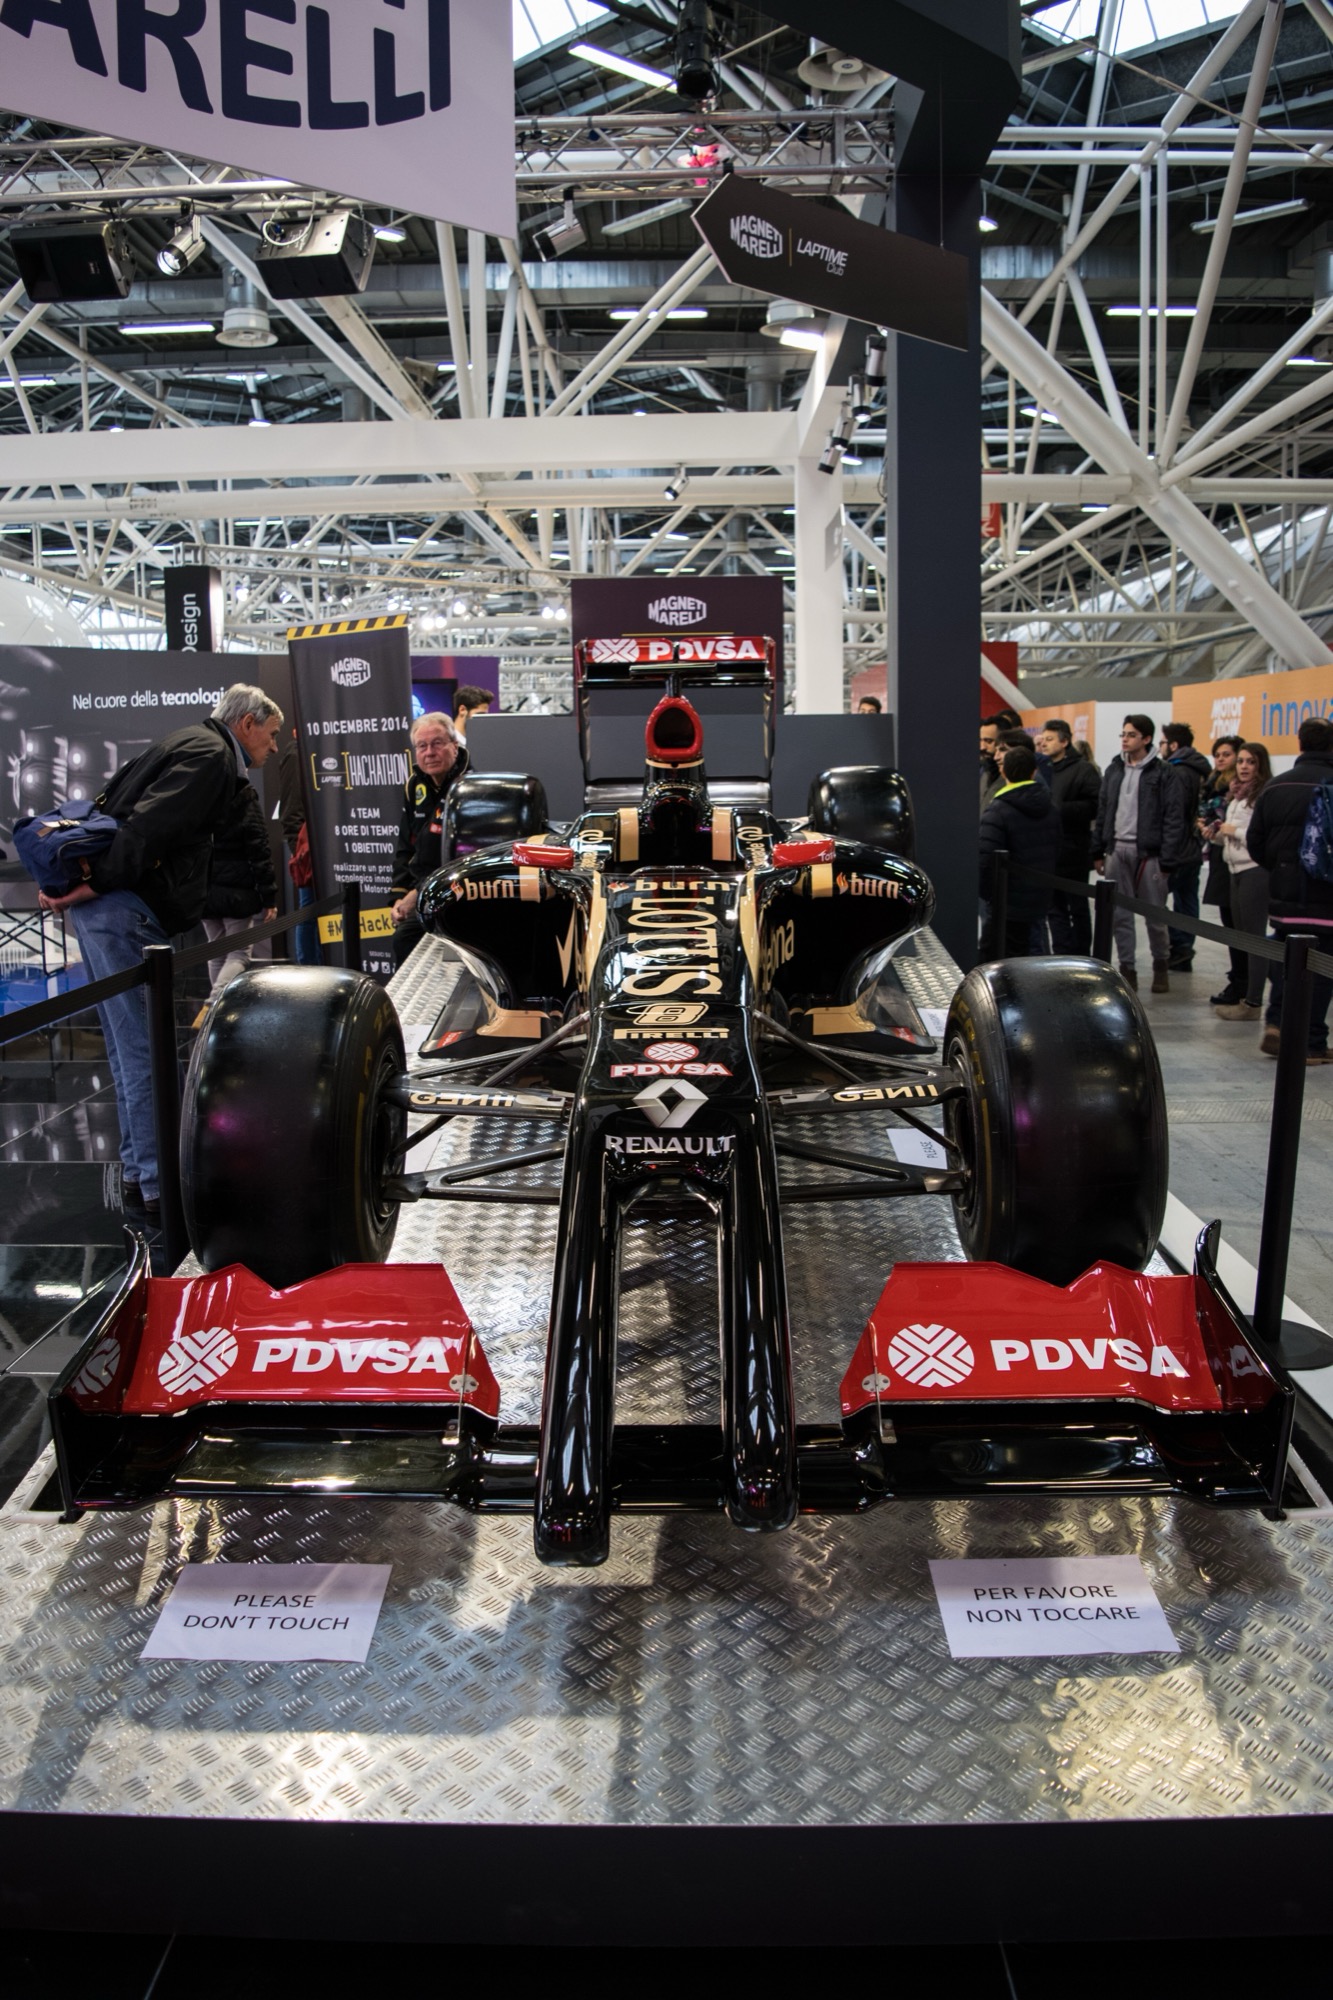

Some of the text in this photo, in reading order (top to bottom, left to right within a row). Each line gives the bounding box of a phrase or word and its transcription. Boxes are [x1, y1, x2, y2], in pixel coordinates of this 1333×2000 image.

[797, 238, 848, 267] LAPTIME
[826, 262, 844, 276] Club
[181, 593, 201, 653] esign
[649, 640, 760, 660] PDVSA
[73, 687, 227, 710] Nel cuore della tecnologi
[307, 716, 409, 736] 10 DICEMBRE 2014
[348, 752, 409, 787] HACKATHON
[350, 808, 381, 819] 4 TEAM
[334, 825, 400, 836] 8 ORE DI TEMPO
[345, 842, 394, 854] 1 OBIETTIVO
[333, 862, 367, 872] realizzare
[464, 878, 516, 900] burn
[635, 879, 731, 893] burn
[850, 873, 900, 899] burn
[621, 896, 724, 996] LOTUS
[633, 1002, 710, 1026] 8
[613, 1027, 730, 1040] PIRELLI
[611, 1063, 733, 1078] PDVSA
[605, 1134, 736, 1155] RENAULT
[252, 1339, 451, 1374] PDVSA
[990, 1337, 1190, 1379] PDVSA
[233, 1594, 318, 1608] PLEASE
[973, 1585, 1119, 1601] PER FAVORE
[266, 1616, 350, 1630] TOUCH
[966, 1606, 1141, 1624] NON TOCCARE
